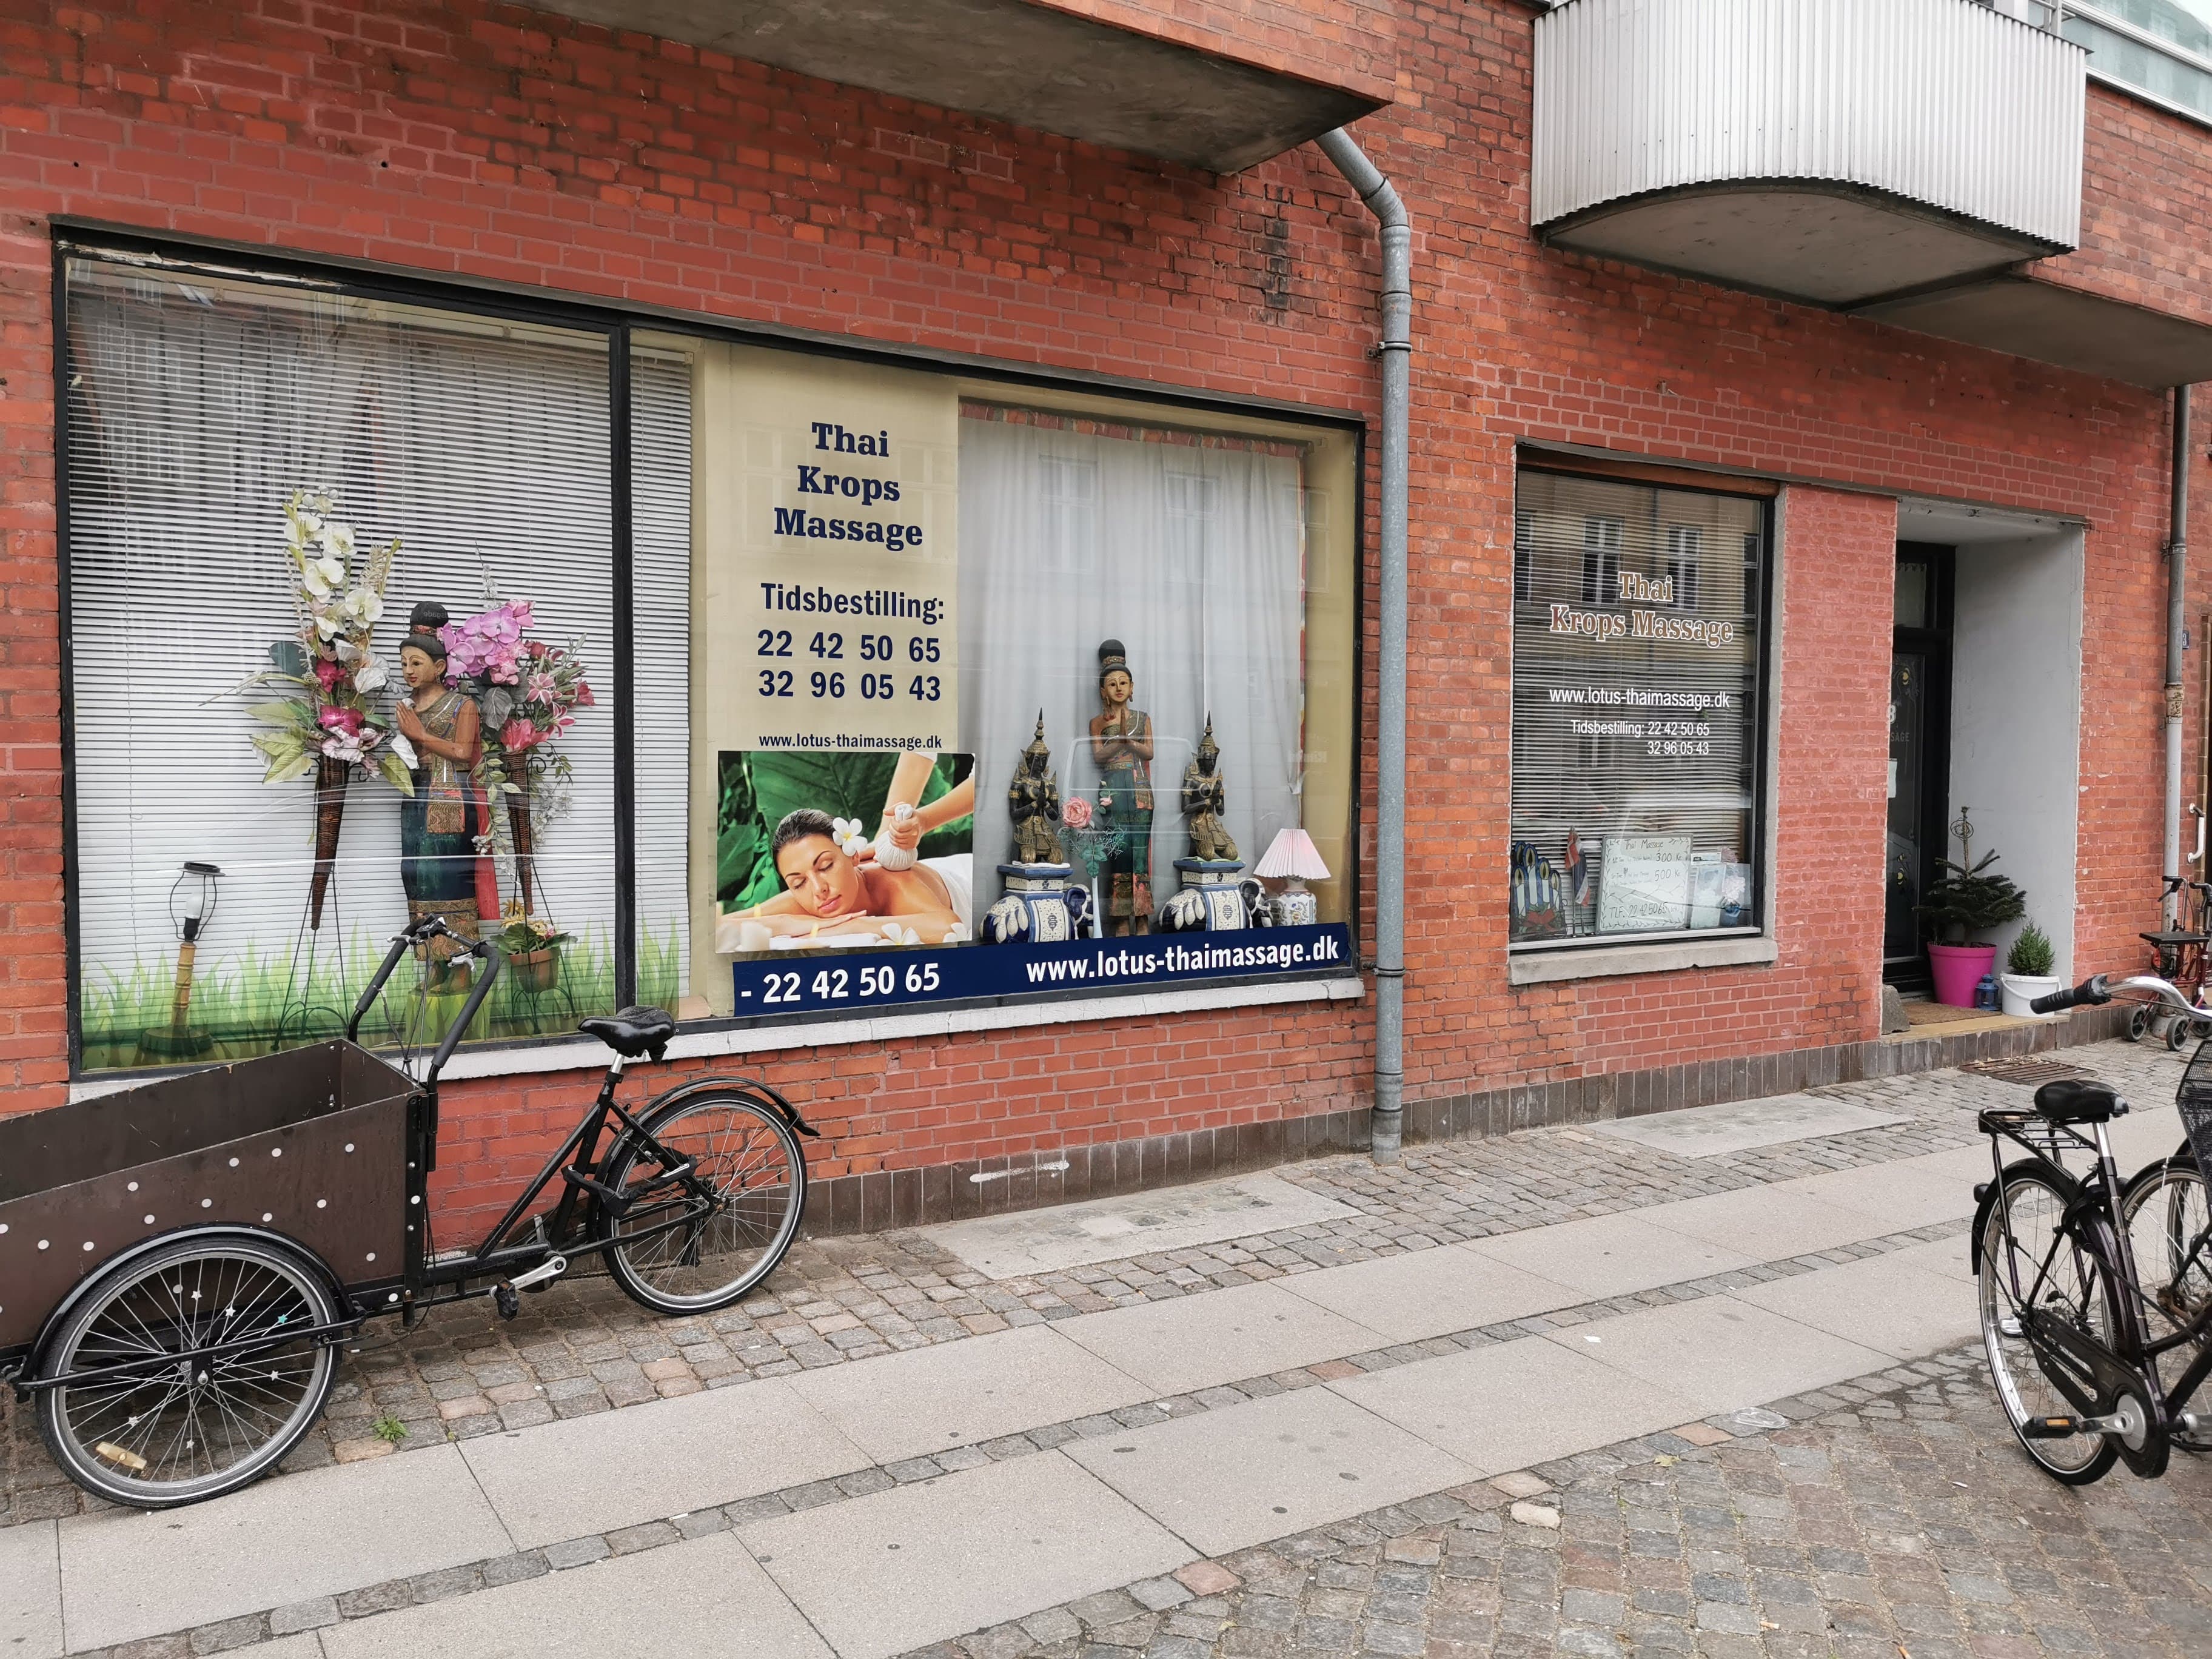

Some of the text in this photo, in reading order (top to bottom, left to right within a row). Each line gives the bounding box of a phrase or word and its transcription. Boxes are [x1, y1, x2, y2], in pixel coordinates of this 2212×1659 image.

[811, 421, 890, 458] Thai
[797, 464, 900, 506] Krops
[774, 507, 923, 552] Massage
[1618, 571, 1674, 602] Thai
[760, 582, 944, 625] Tidsbestilling:
[1550, 605, 1733, 648] Krops Massage
[757, 629, 940, 663] 22 42 50 65
[759, 669, 940, 702] 32 96 05 43
[1549, 686, 1730, 711] www.lotus-thaimassage.dk
[759, 733, 942, 750] www.lotus-thaimassage.dk
[1570, 719, 1710, 738] Tidsbestilling: 22 42 50 65
[1647, 741, 1709, 755] 32 96 05 43
[1624, 839, 1637, 850] Thai
[1656, 853, 1672, 862] 300
[1655, 869, 1672, 881] 500
[763, 972, 801, 1003] 22
[812, 969, 848, 999] 42
[859, 965, 895, 997] 50
[905, 962, 940, 992] 65
[1026, 935, 1339, 983] www.lotus-thaimassage.dk
